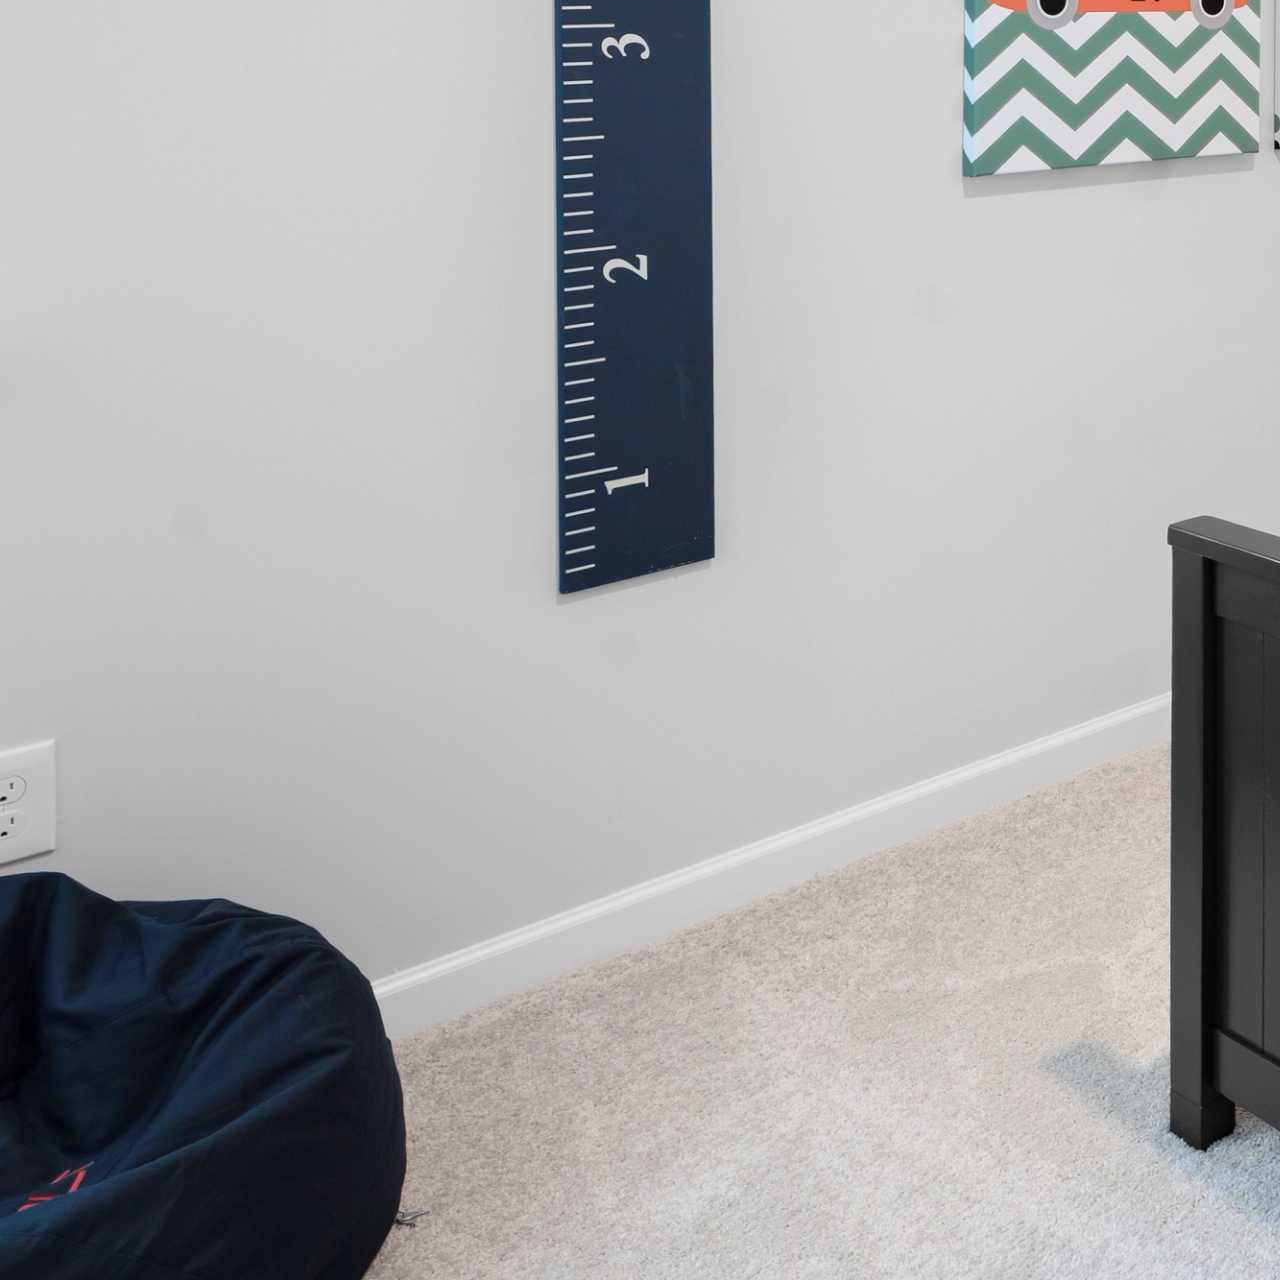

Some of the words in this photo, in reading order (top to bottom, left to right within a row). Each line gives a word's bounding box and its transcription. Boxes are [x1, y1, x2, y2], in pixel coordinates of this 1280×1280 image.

[601, 32, 651, 60] 3
[603, 253, 648, 284] 2
[604, 466, 649, 494] 1
